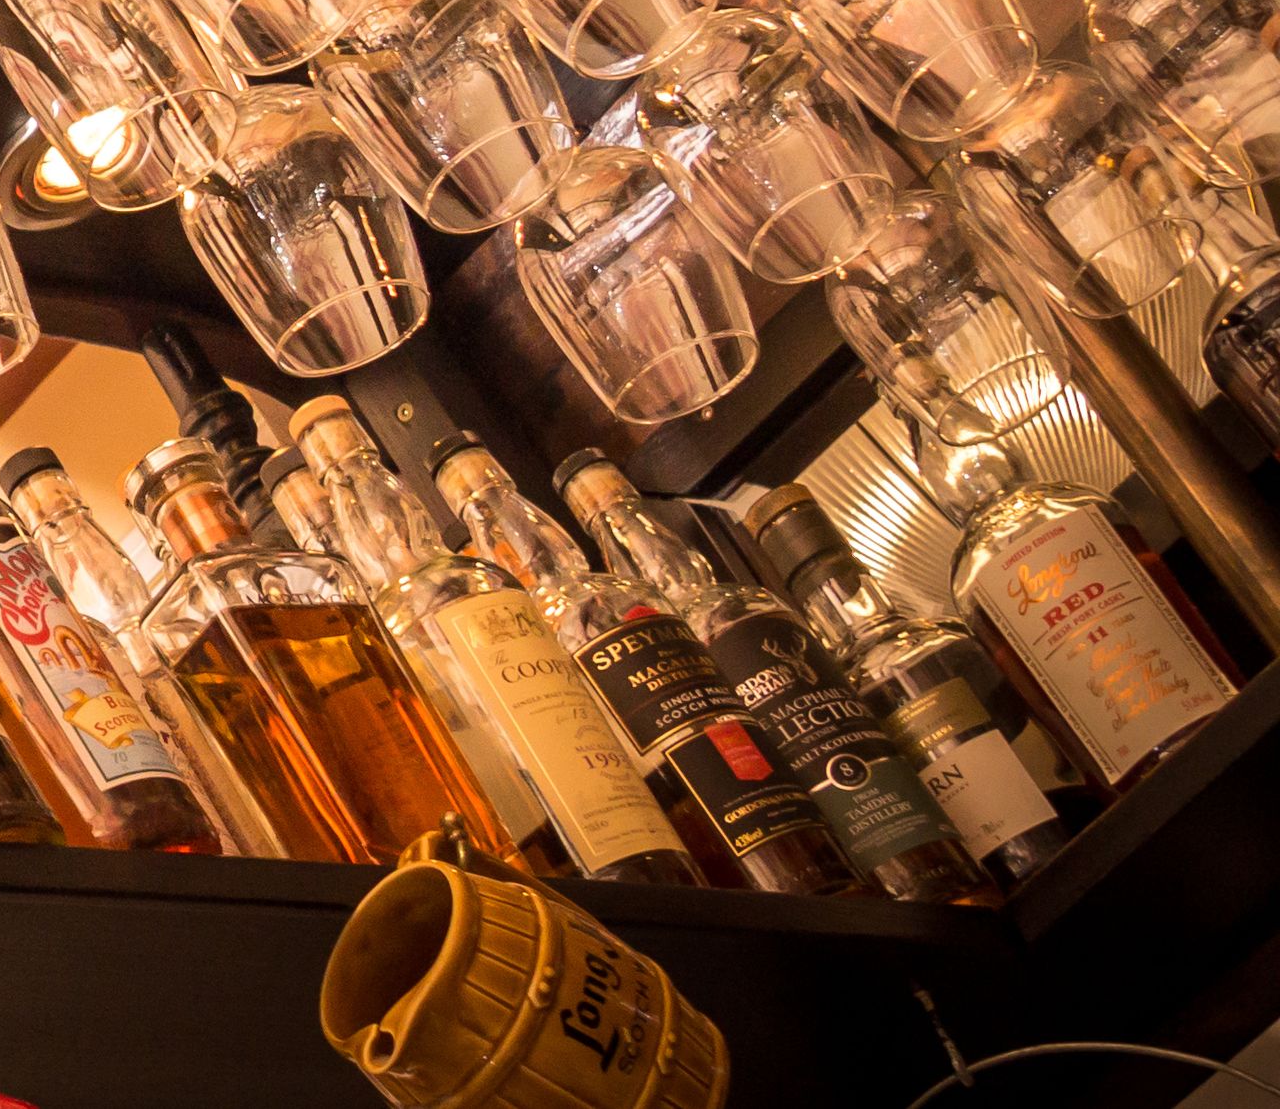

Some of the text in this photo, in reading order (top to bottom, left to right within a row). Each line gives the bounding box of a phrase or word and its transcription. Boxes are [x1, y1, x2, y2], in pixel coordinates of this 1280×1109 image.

[1001, 523, 1067, 572] LIMITED EDITION
[1007, 541, 1101, 617] Longrow
[1041, 581, 1106, 632] RED
[1046, 591, 1127, 648] FRESH PORT CASKS
[1086, 624, 1110, 645] 11
[735, 664, 786, 696] RDON
[655, 699, 709, 729] SCOTCH
[659, 688, 704, 712] SINGLE
[789, 734, 861, 771] MALT SCOTCH
[839, 760, 854, 777] 8
[927, 763, 966, 798] RN
[845, 790, 898, 822] TAMDHU
